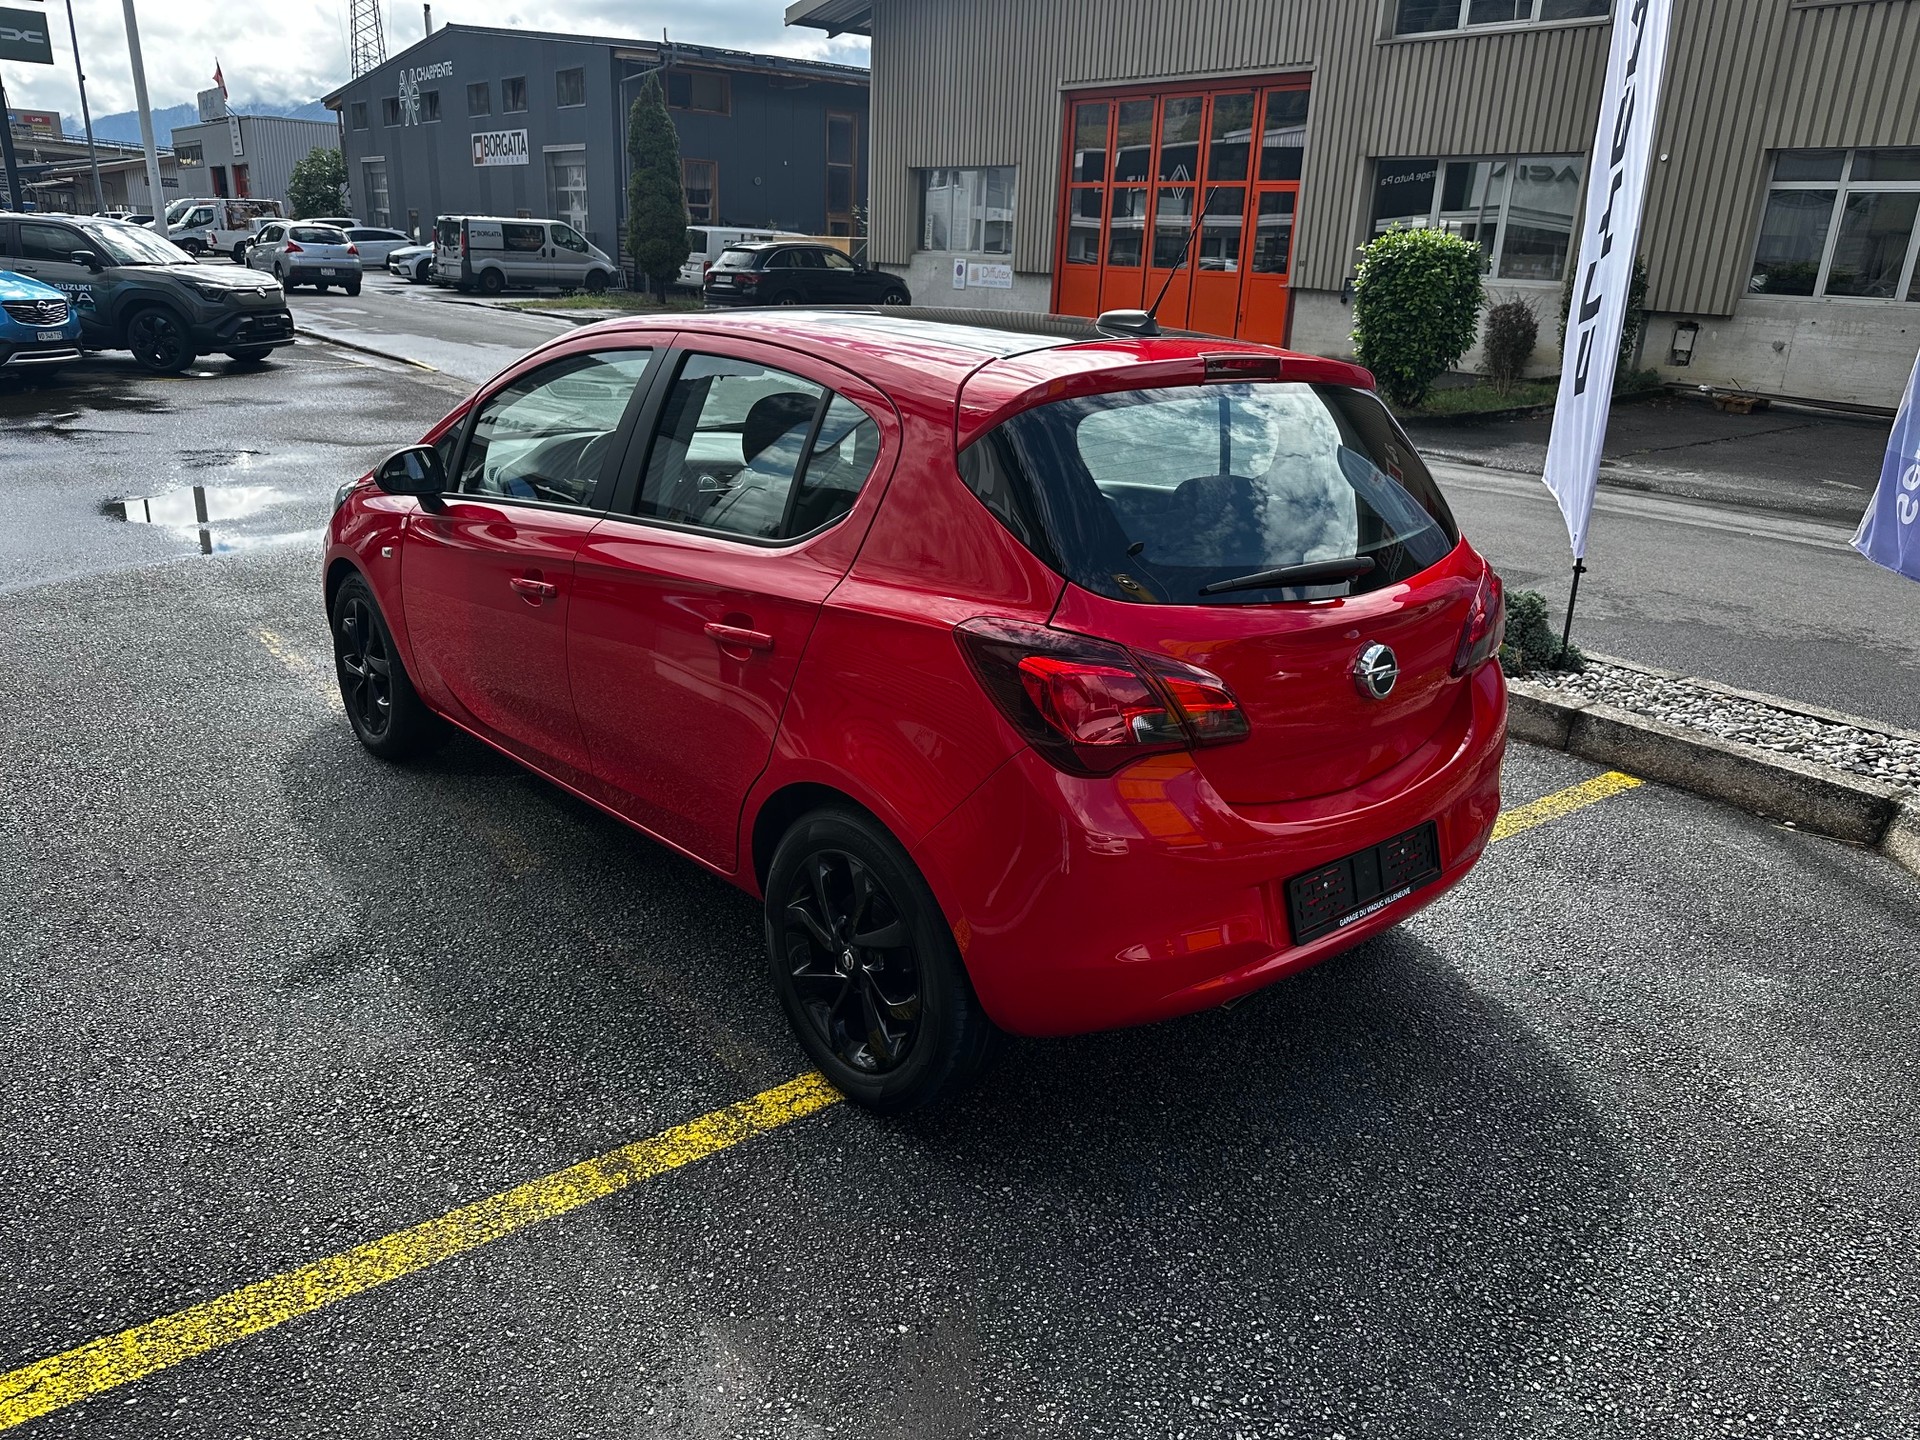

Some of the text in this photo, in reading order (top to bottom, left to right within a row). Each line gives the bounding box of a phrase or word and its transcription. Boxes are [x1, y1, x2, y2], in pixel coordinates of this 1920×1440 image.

[416, 61, 453, 82] CHARPENTE
[484, 132, 528, 157] BORGATTA
[54, 283, 92, 292] SUZUKI
[1339, 887, 1411, 927] GARAGE DU VIADUC VILLENEUVE
